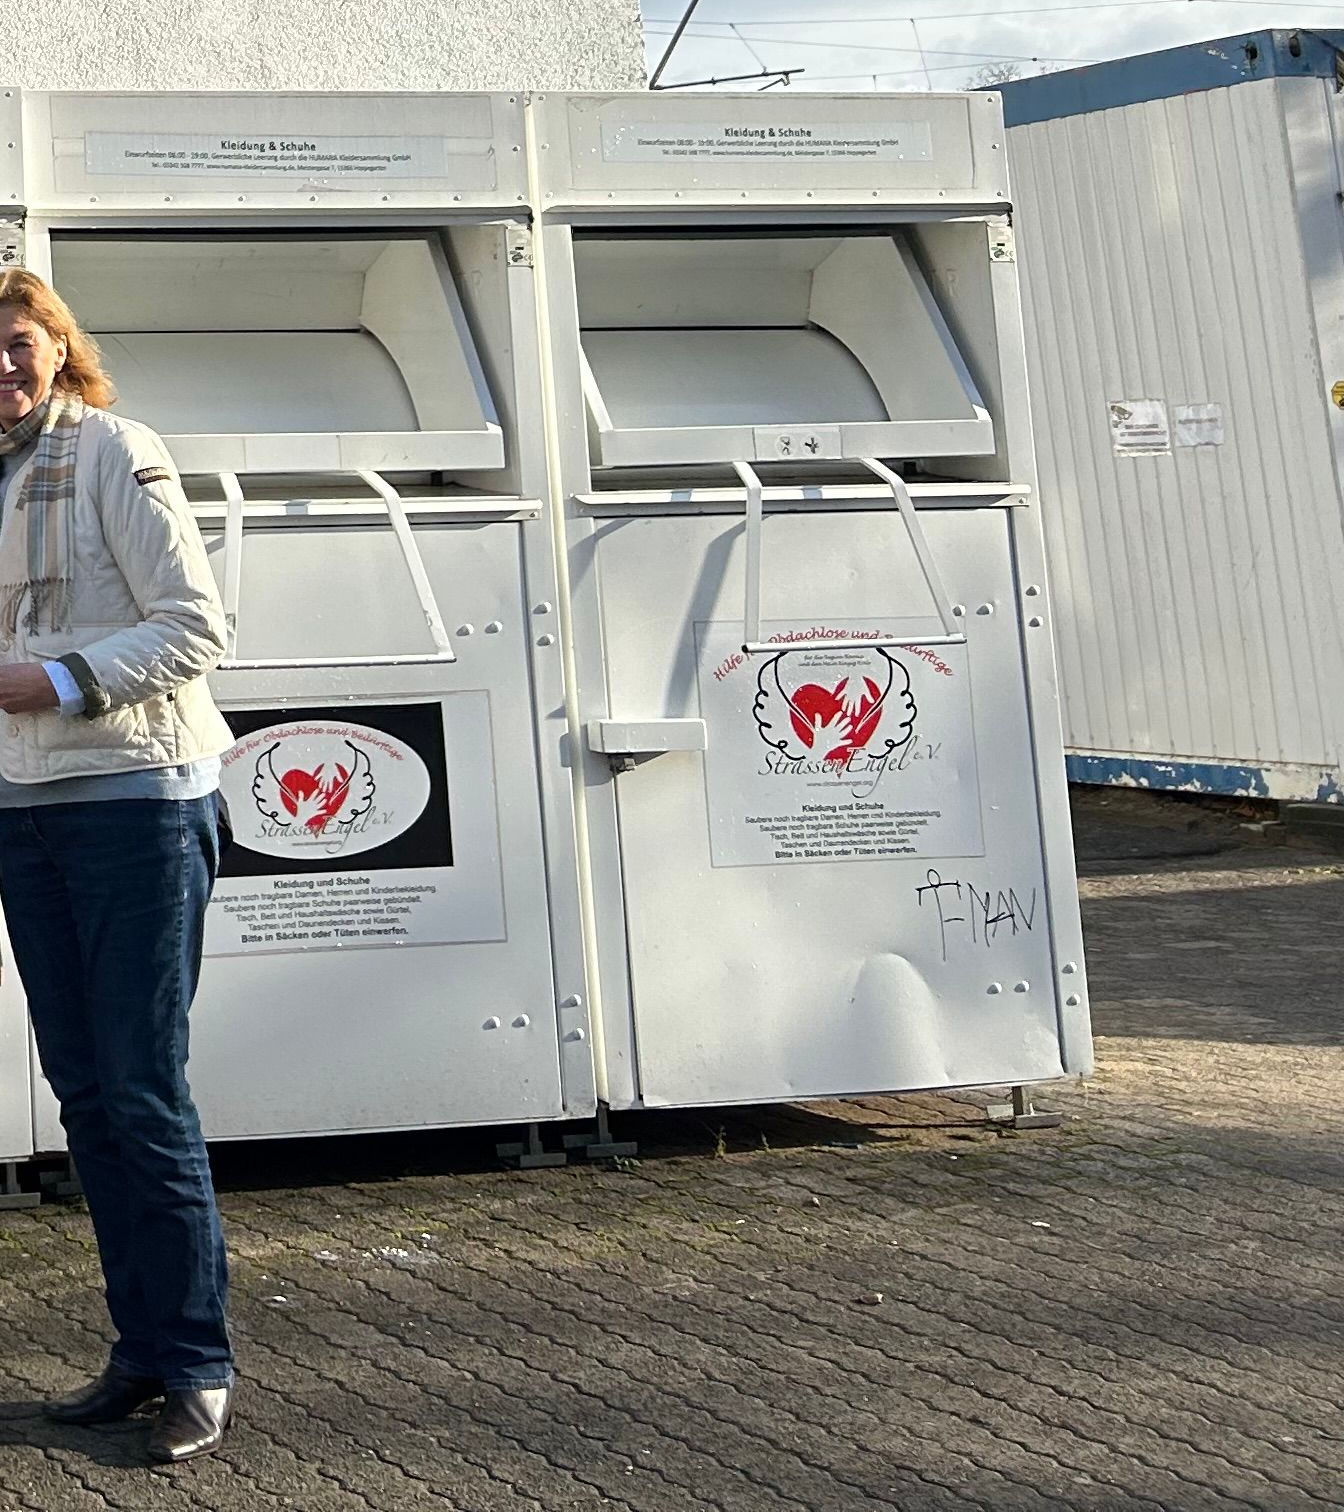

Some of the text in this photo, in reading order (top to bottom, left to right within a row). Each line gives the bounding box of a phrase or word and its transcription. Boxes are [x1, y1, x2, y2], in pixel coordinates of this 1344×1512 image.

[725, 128, 811, 138] Kleidung & Schuhe
[221, 140, 316, 152] Kleidung & Schuhe
[713, 654, 743, 681] Hilfe
[273, 877, 370, 889] Kleidung und Schuhe
[311, 930, 332, 939] oder
[334, 928, 360, 937] Tüten
